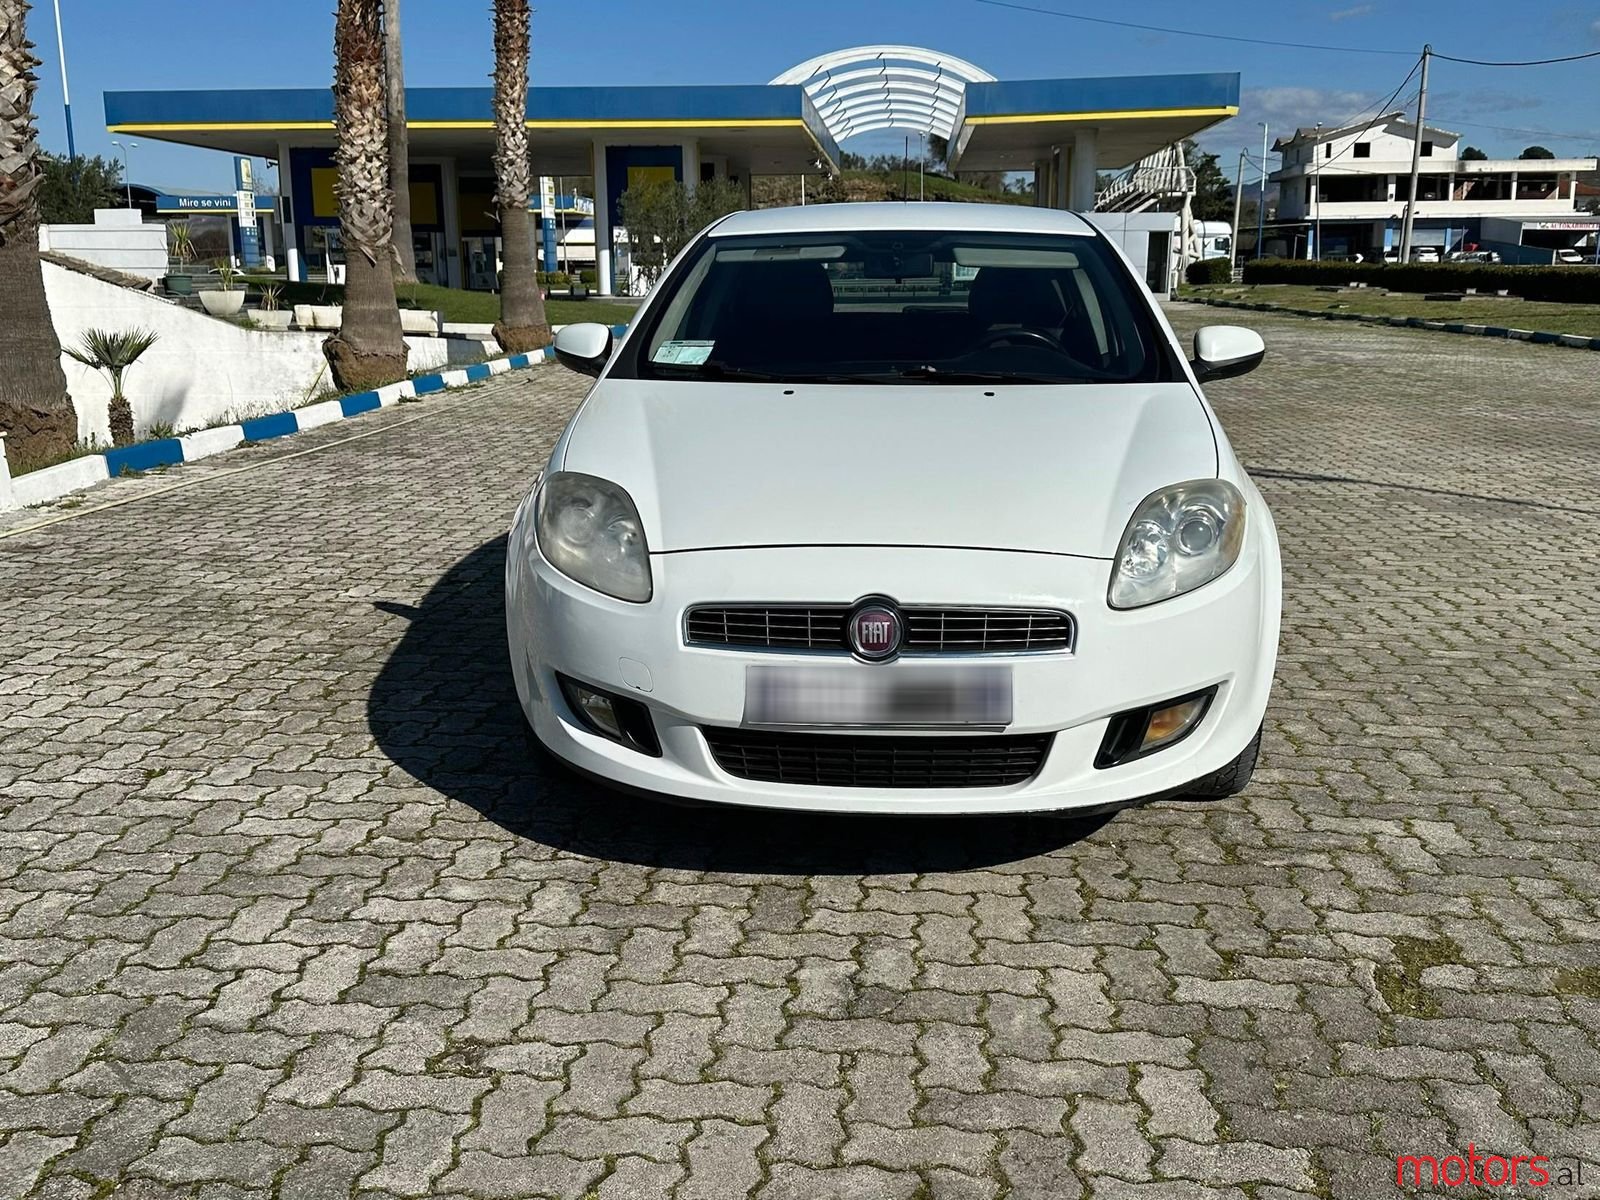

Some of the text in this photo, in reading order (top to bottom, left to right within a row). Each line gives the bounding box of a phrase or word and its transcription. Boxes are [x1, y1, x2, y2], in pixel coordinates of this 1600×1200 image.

[201, 200, 212, 208] se
[214, 198, 231, 208] vini
[861, 621, 891, 644] FIAT
